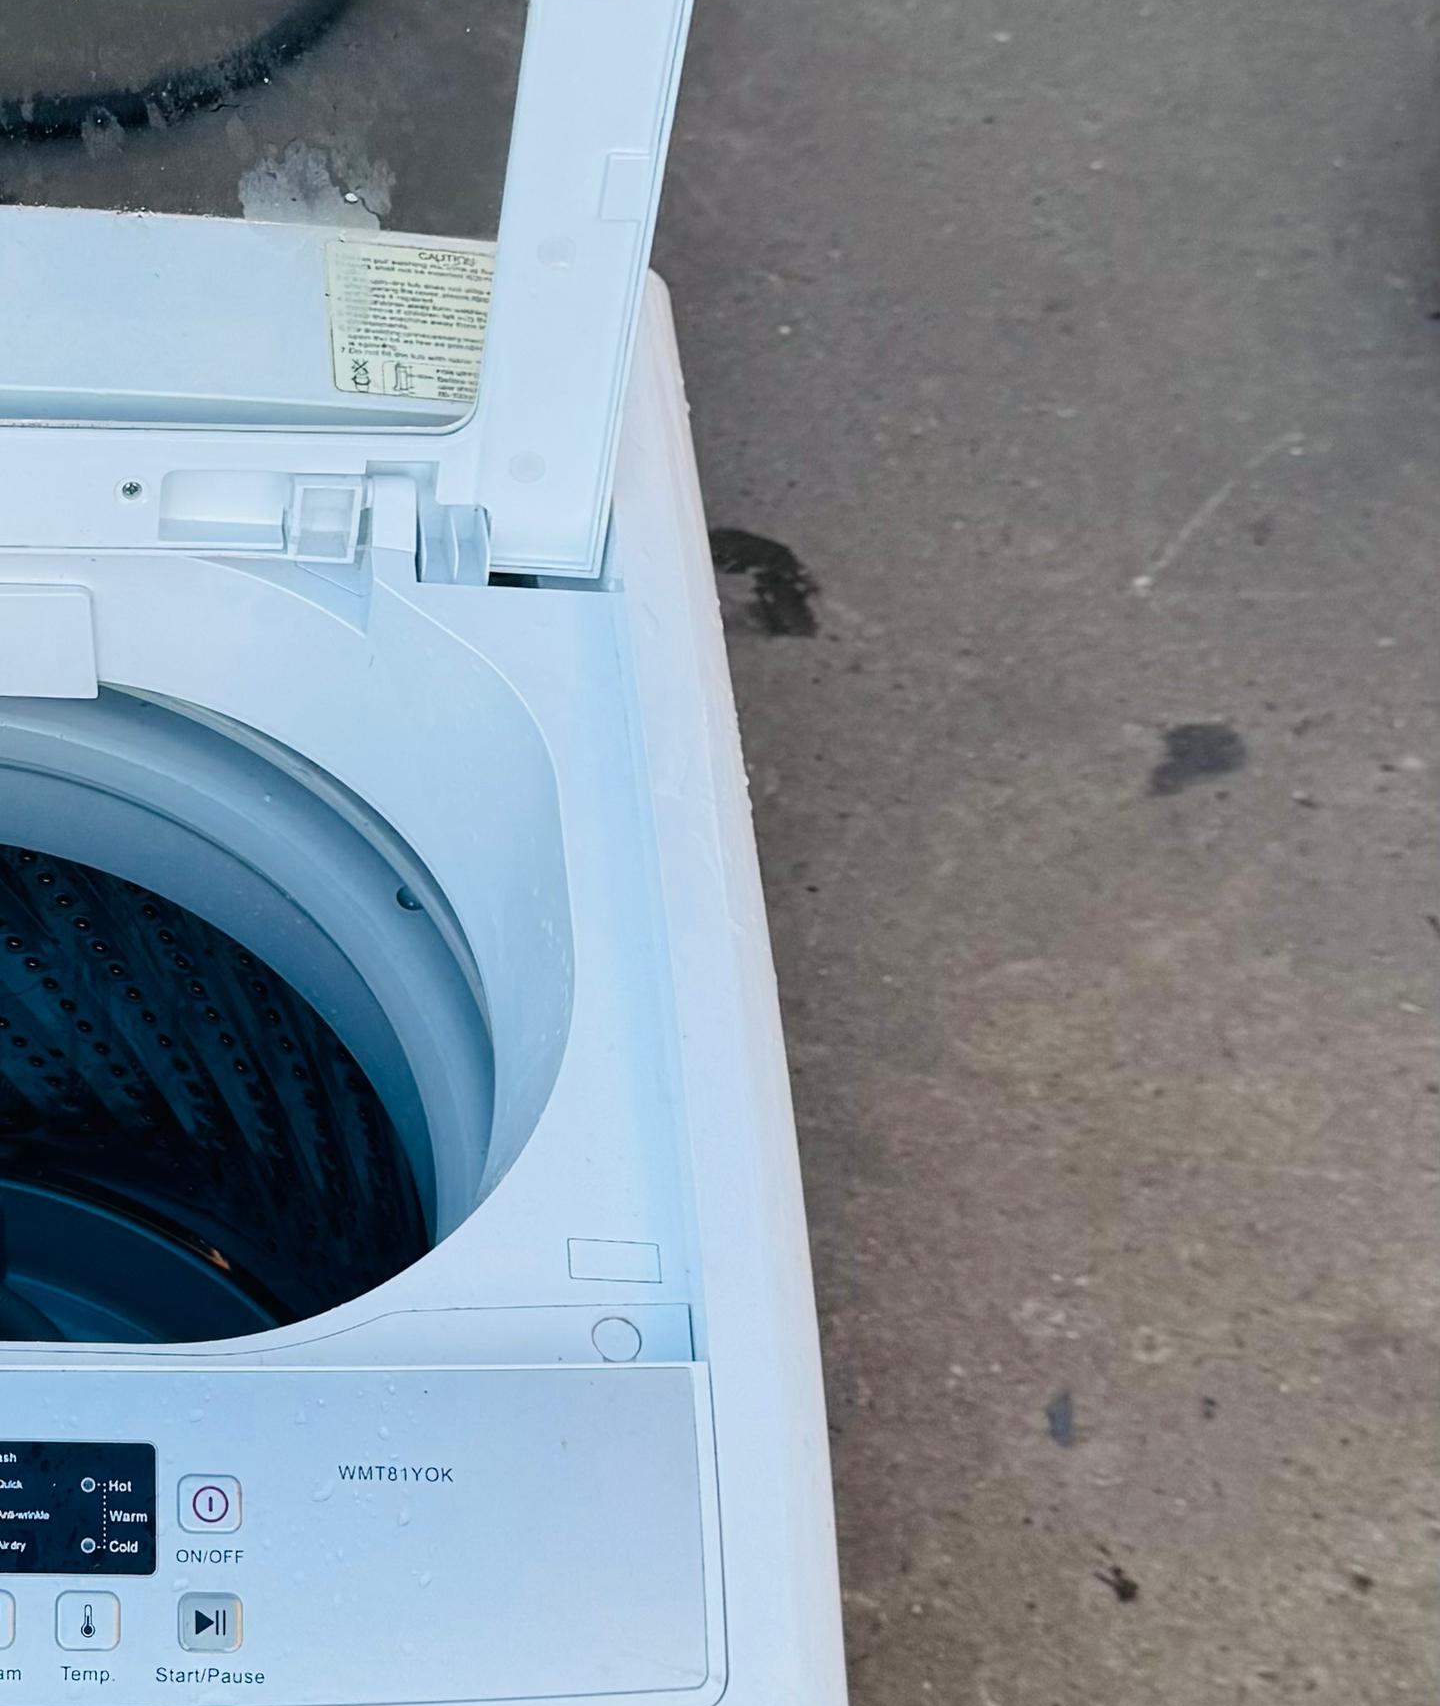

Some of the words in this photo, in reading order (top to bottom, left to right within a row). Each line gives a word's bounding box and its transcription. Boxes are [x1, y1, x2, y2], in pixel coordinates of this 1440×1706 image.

[337, 1465, 454, 1483] WMT81YOK
[109, 1480, 132, 1492] Hot
[109, 1511, 148, 1522] Warm
[109, 1541, 138, 1553] Cold
[175, 1549, 245, 1564] ON/OFF
[60, 1666, 116, 1684] Temp.
[155, 1666, 266, 1684] Start/Pause
